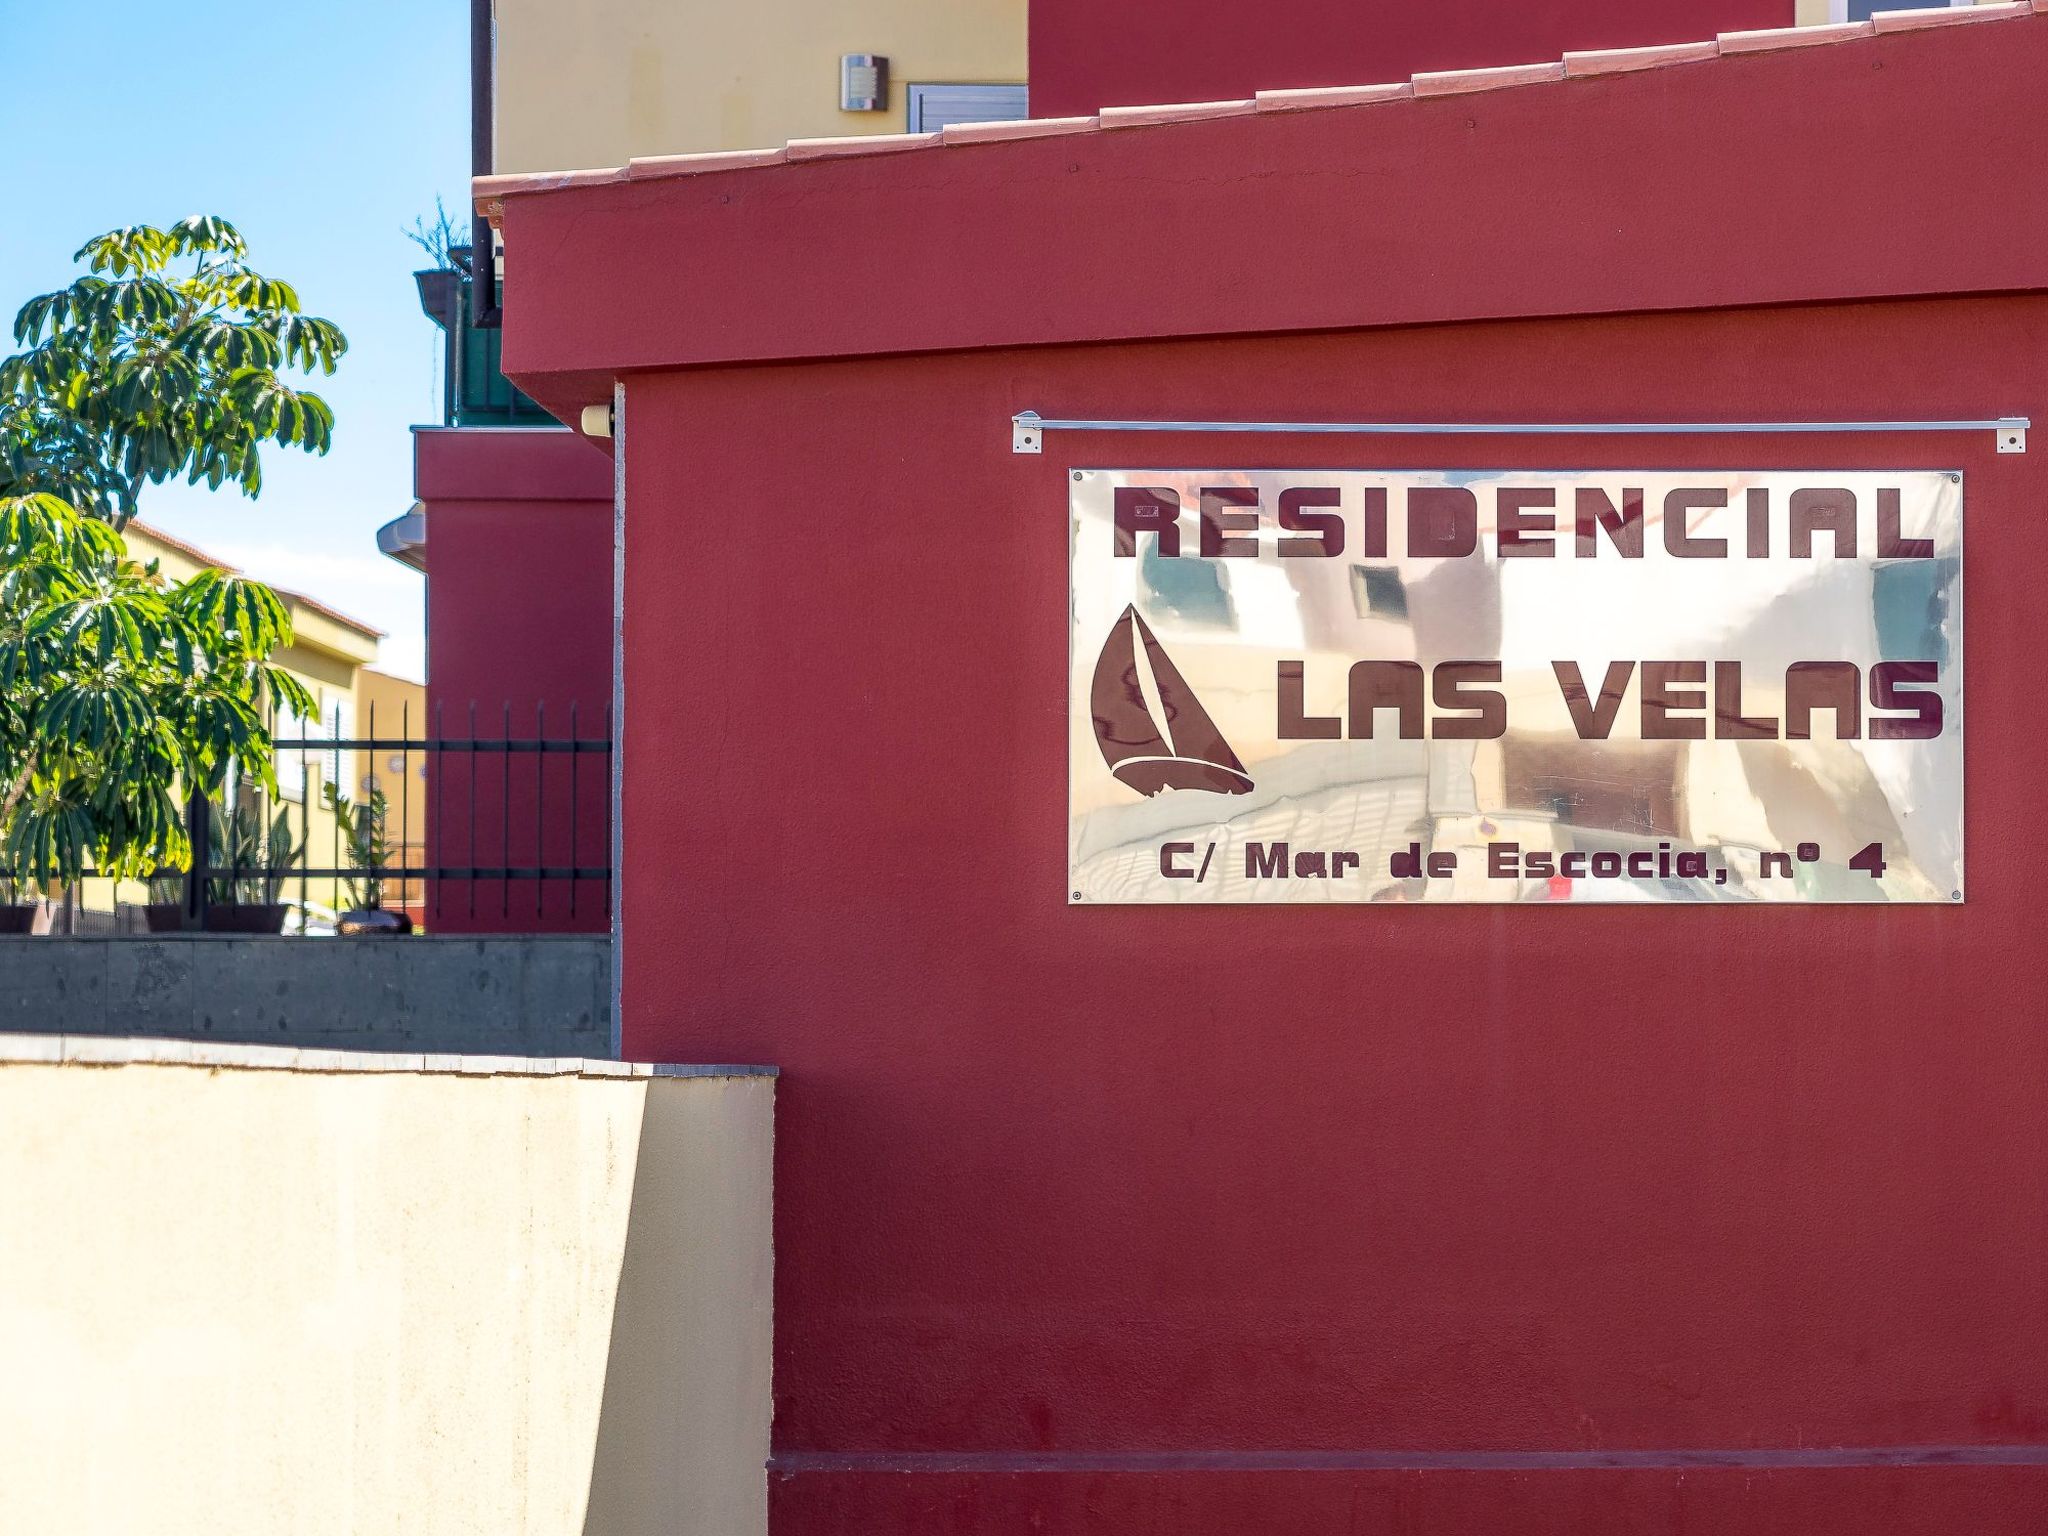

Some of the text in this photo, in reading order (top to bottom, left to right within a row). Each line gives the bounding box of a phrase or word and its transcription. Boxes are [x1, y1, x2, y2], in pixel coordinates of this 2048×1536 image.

[1113, 486, 1935, 559] RESIDENCIAL
[1277, 660, 1944, 741] LAS VELAS
[1159, 842, 1217, 883] C/
[1244, 842, 1360, 879] Mar
[1389, 842, 1458, 879] de
[1487, 842, 1728, 885] Escocia,
[1848, 842, 1887, 879] 4
